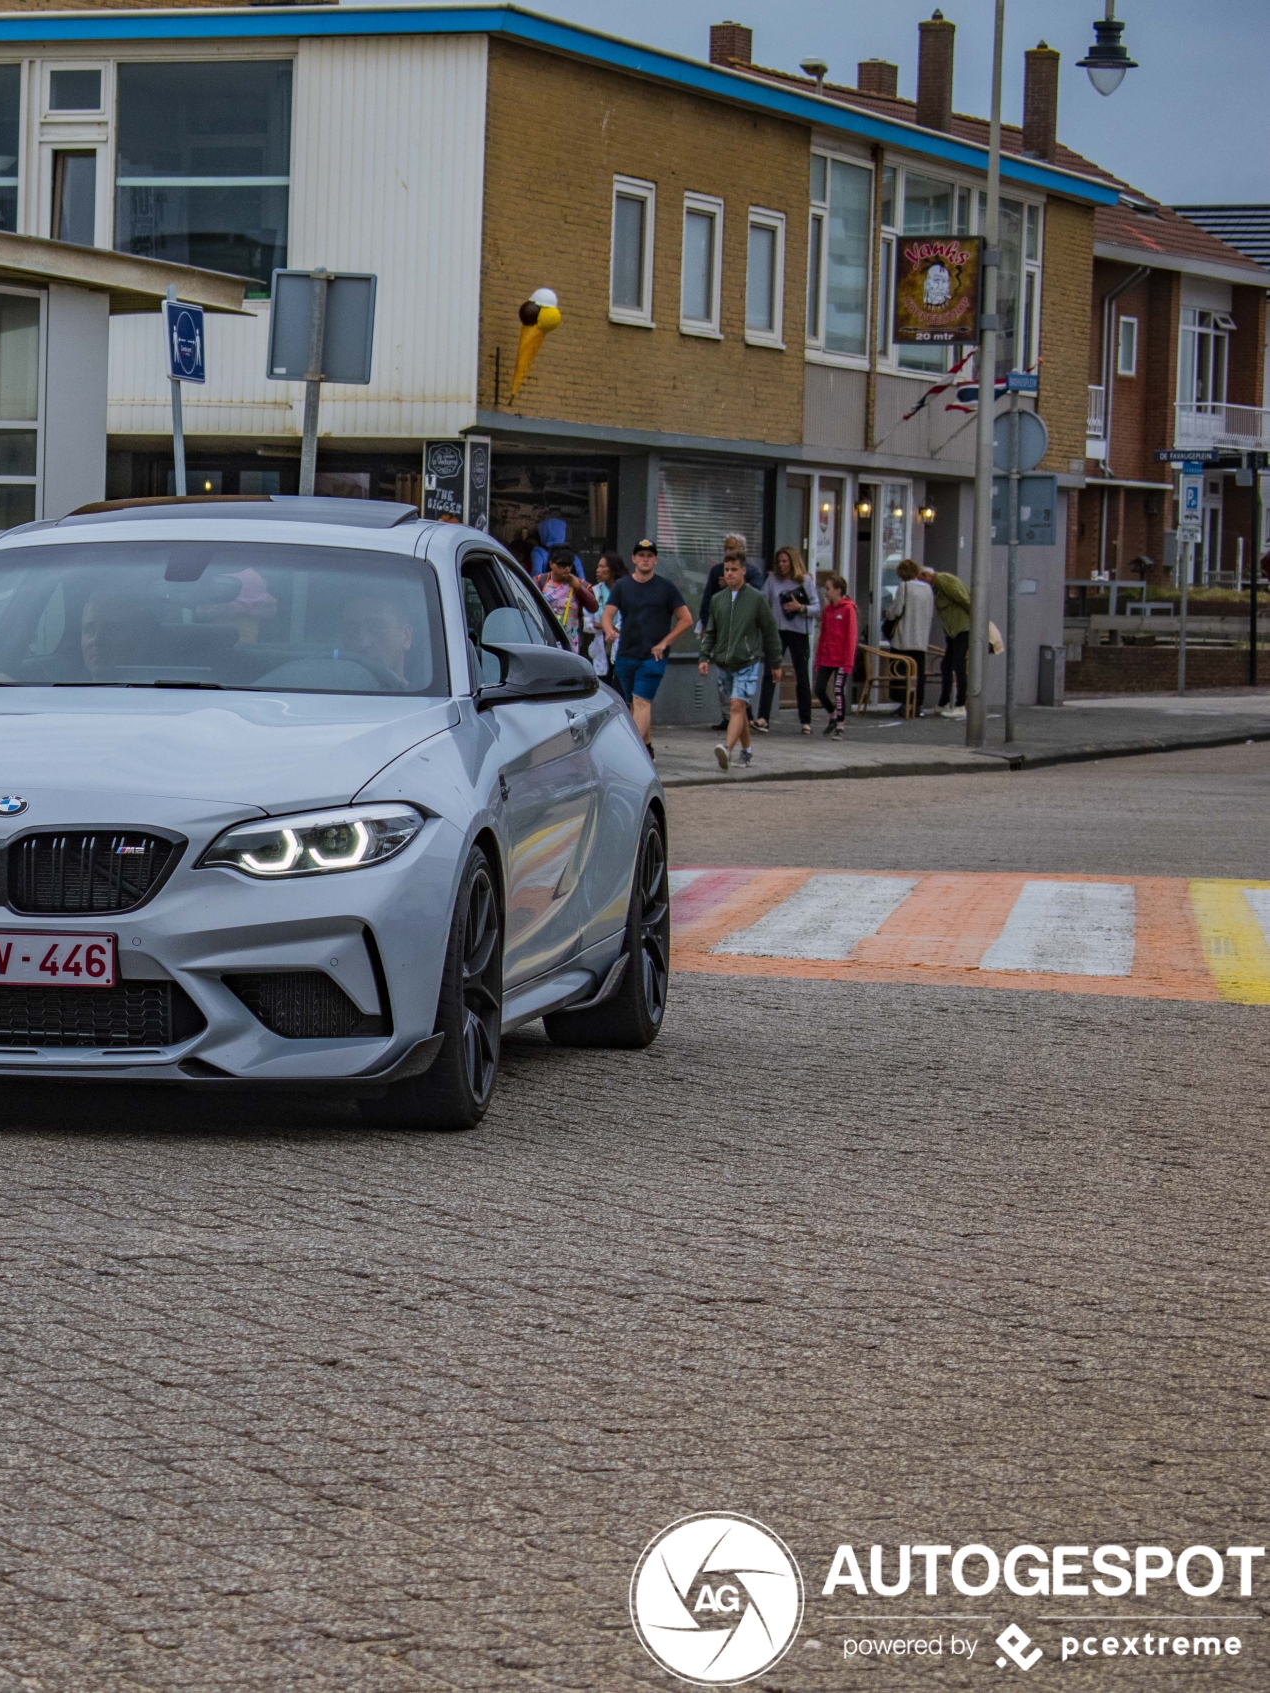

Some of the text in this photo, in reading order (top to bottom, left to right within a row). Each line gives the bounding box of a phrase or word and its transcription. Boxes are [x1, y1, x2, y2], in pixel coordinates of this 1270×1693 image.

[904, 241, 971, 270] Yanks
[903, 297, 970, 325] COFFEESHOP
[916, 333, 954, 341] 20 mtr
[435, 488, 454, 501] THE
[427, 498, 462, 514] BIGGER
